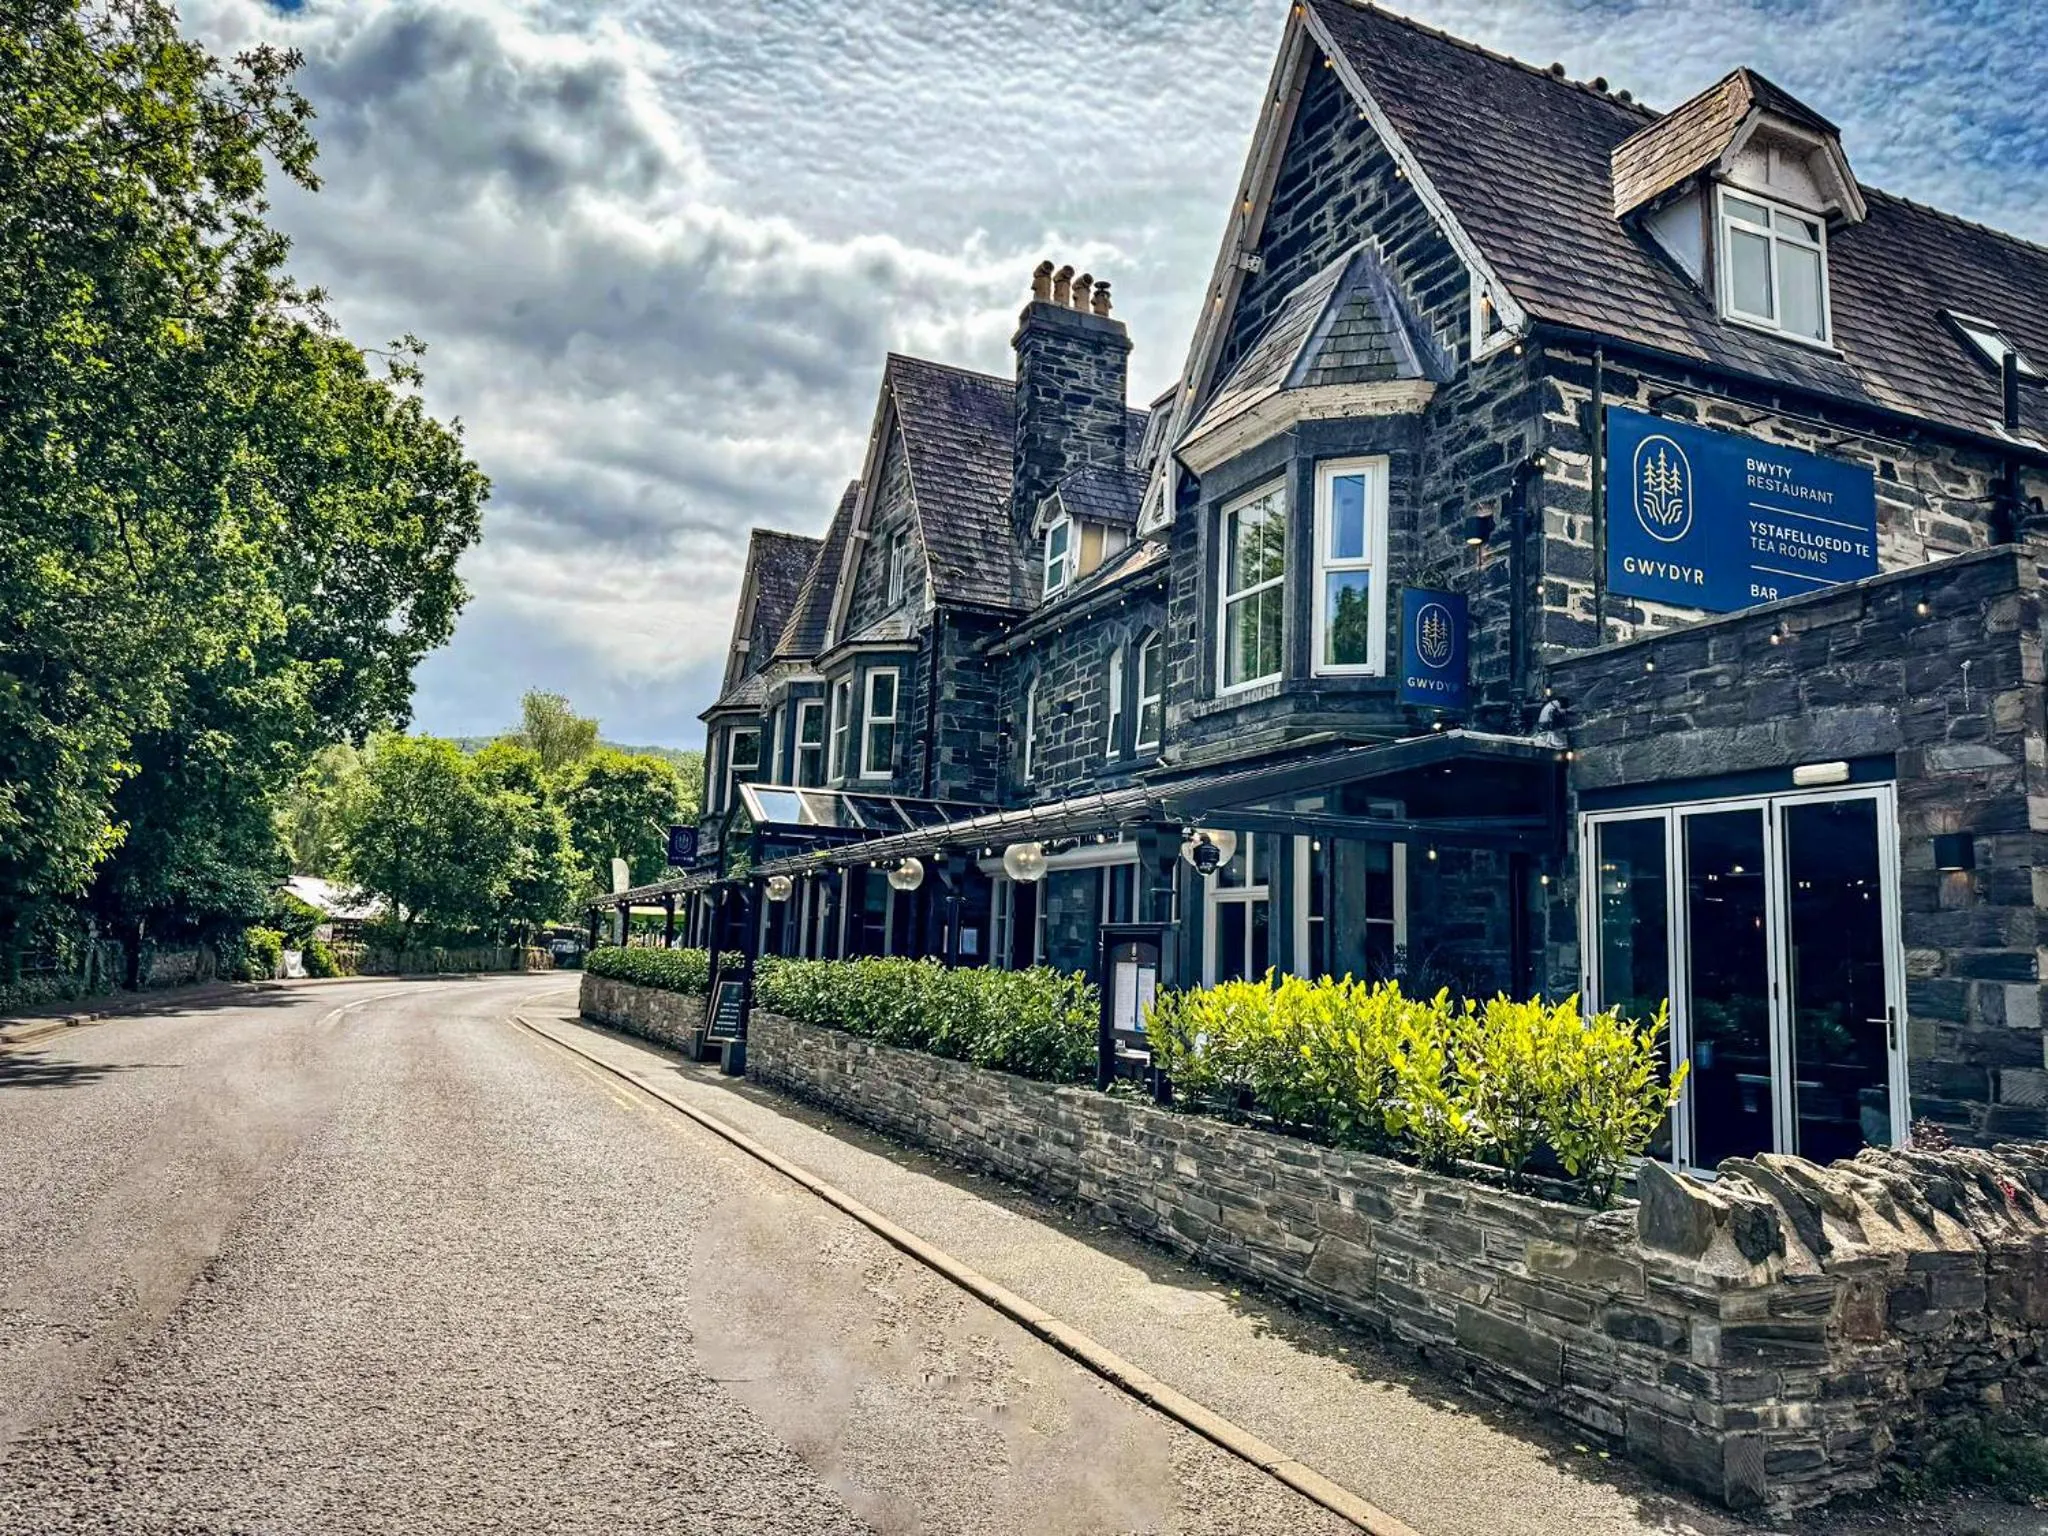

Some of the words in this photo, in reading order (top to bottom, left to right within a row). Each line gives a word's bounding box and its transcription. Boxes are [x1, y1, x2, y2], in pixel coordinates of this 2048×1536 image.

[1746, 458, 1792, 480] BWYTY
[1747, 474, 1834, 504] RESTAURANT
[1750, 520, 1851, 553] YSTAFELLOEDD
[1855, 543, 1870, 558] TE
[1750, 536, 1775, 552] TEA
[1779, 543, 1828, 564] ROOMS
[1623, 556, 1704, 585] GWYDYR
[1750, 584, 1777, 601] BAR
[1407, 676, 1459, 692] GWYDY
